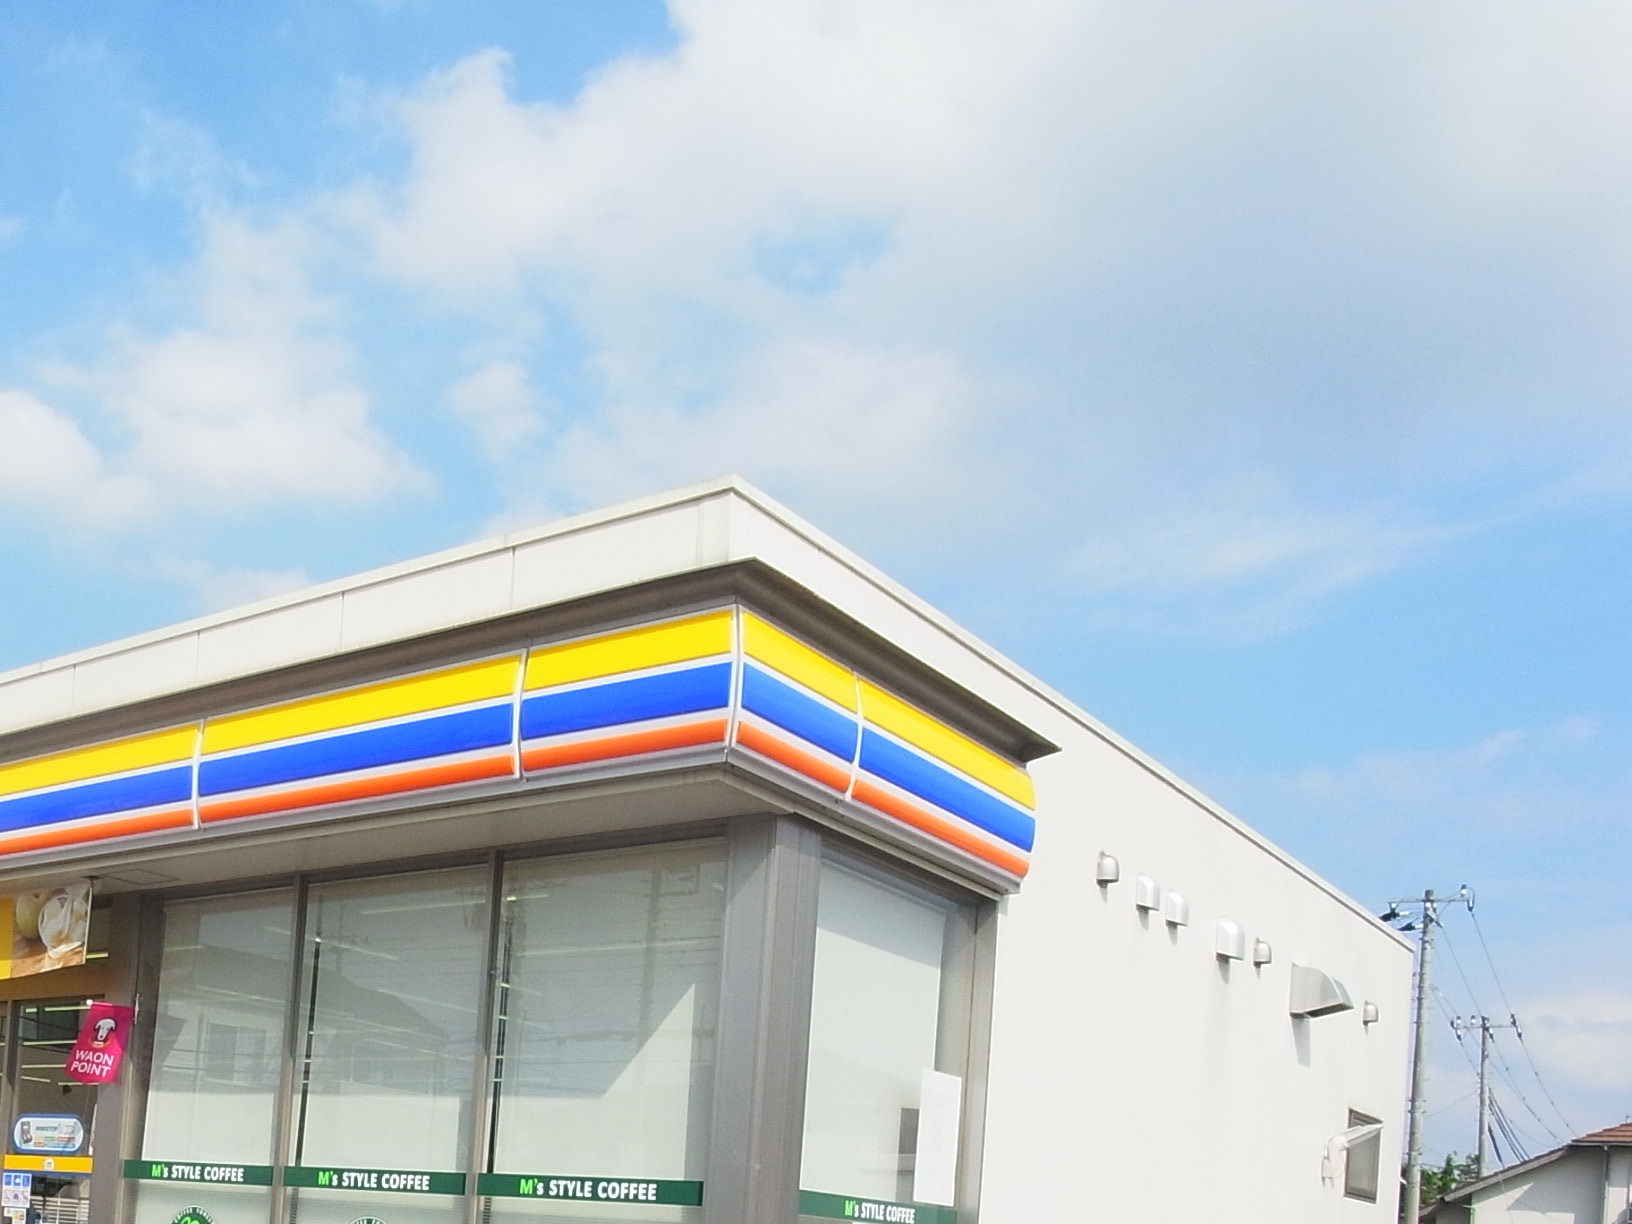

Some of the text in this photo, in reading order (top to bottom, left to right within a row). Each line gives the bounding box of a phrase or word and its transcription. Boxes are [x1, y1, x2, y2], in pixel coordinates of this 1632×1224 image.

[75, 1049, 115, 1066] WAON
[70, 1061, 111, 1078] POINT
[151, 1163, 244, 1182] M's STYLE COFFEE
[318, 1171, 430, 1191] M's STYLE COFFEE
[519, 1178, 658, 1201] M's STYLE COFFEE
[845, 1200, 916, 1224] M's STYLE COFFEE
